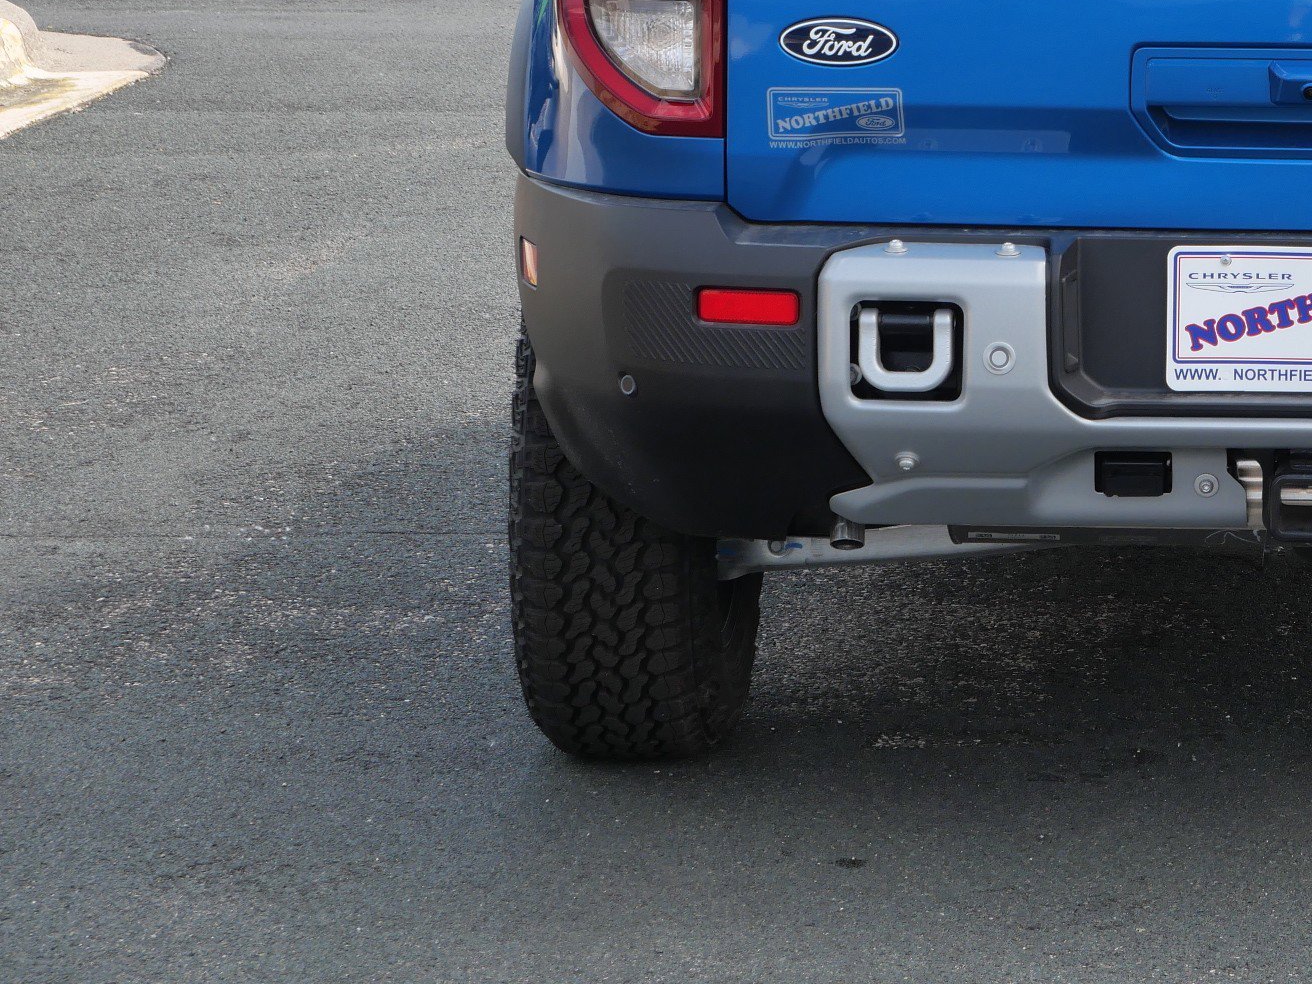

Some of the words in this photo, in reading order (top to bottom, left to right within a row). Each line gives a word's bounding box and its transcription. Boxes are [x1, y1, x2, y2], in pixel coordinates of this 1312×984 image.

[802, 26, 874, 57] Ford
[776, 97, 894, 133] NORTHFIELD
[865, 118, 888, 128] Ford
[769, 137, 907, 149] WWW.NORTHFIELDAUTOS.COM
[1188, 272, 1293, 281] CHRYSLER
